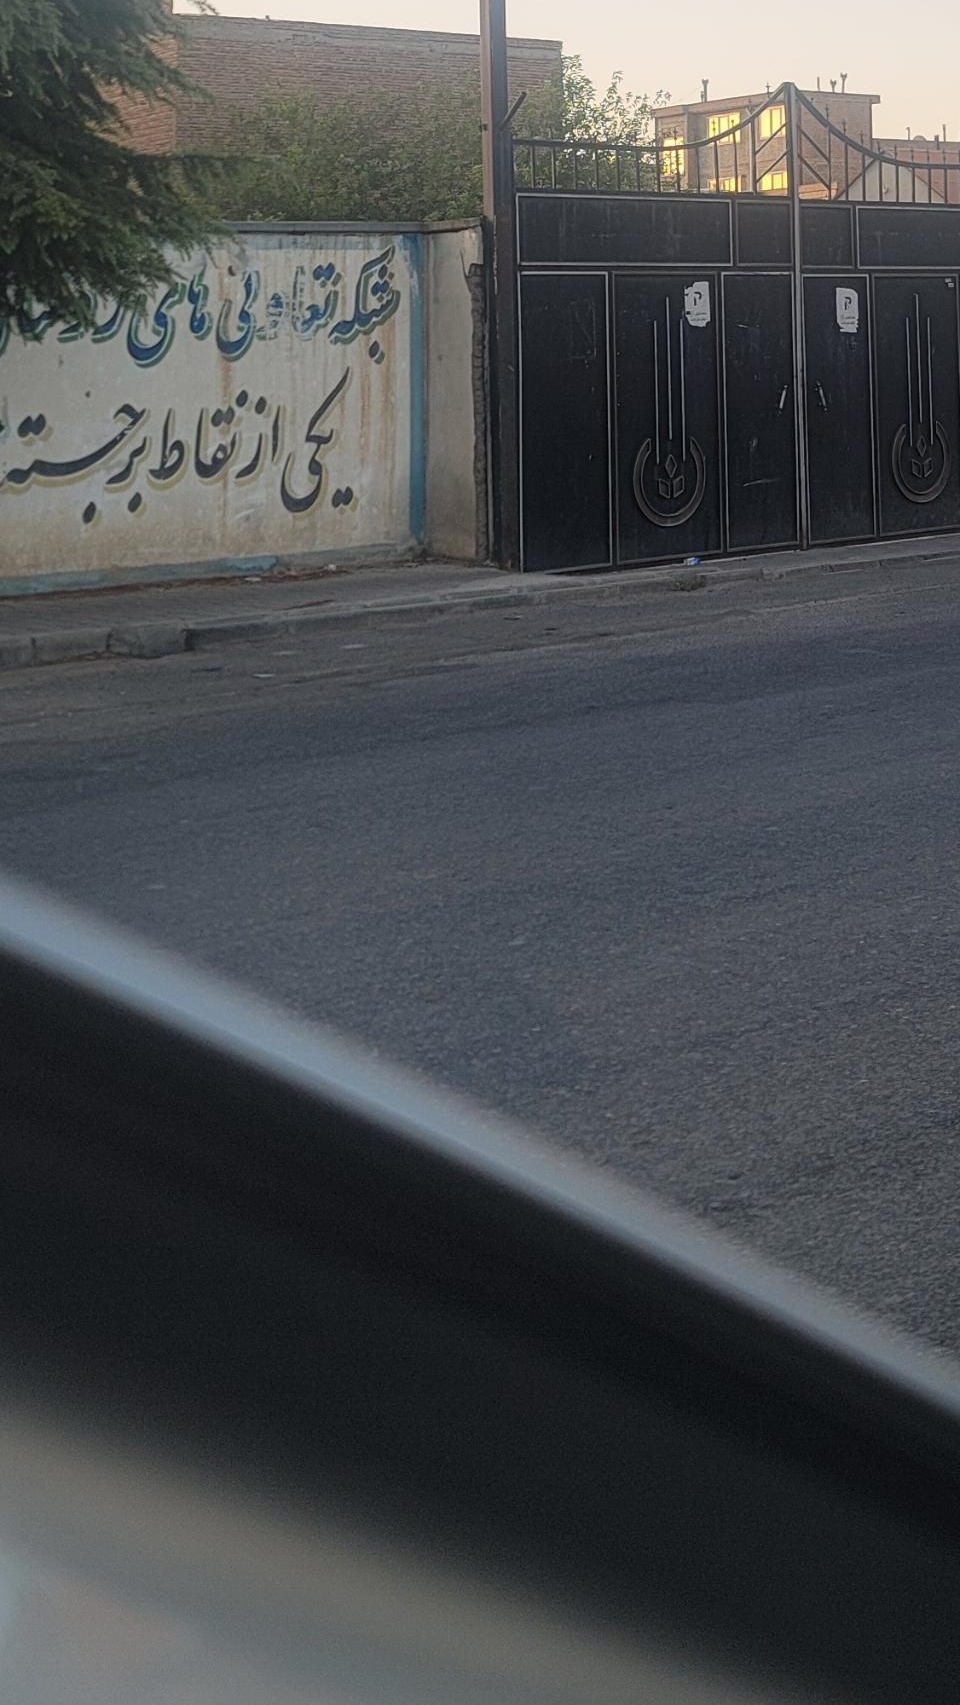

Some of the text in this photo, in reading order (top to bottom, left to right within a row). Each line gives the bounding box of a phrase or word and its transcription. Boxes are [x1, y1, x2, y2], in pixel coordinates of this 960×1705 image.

[328, 245, 400, 365] شبکه
[148, 390, 249, 486] نقاط
[235, 397, 284, 482] از
[280, 366, 360, 514] یکی
